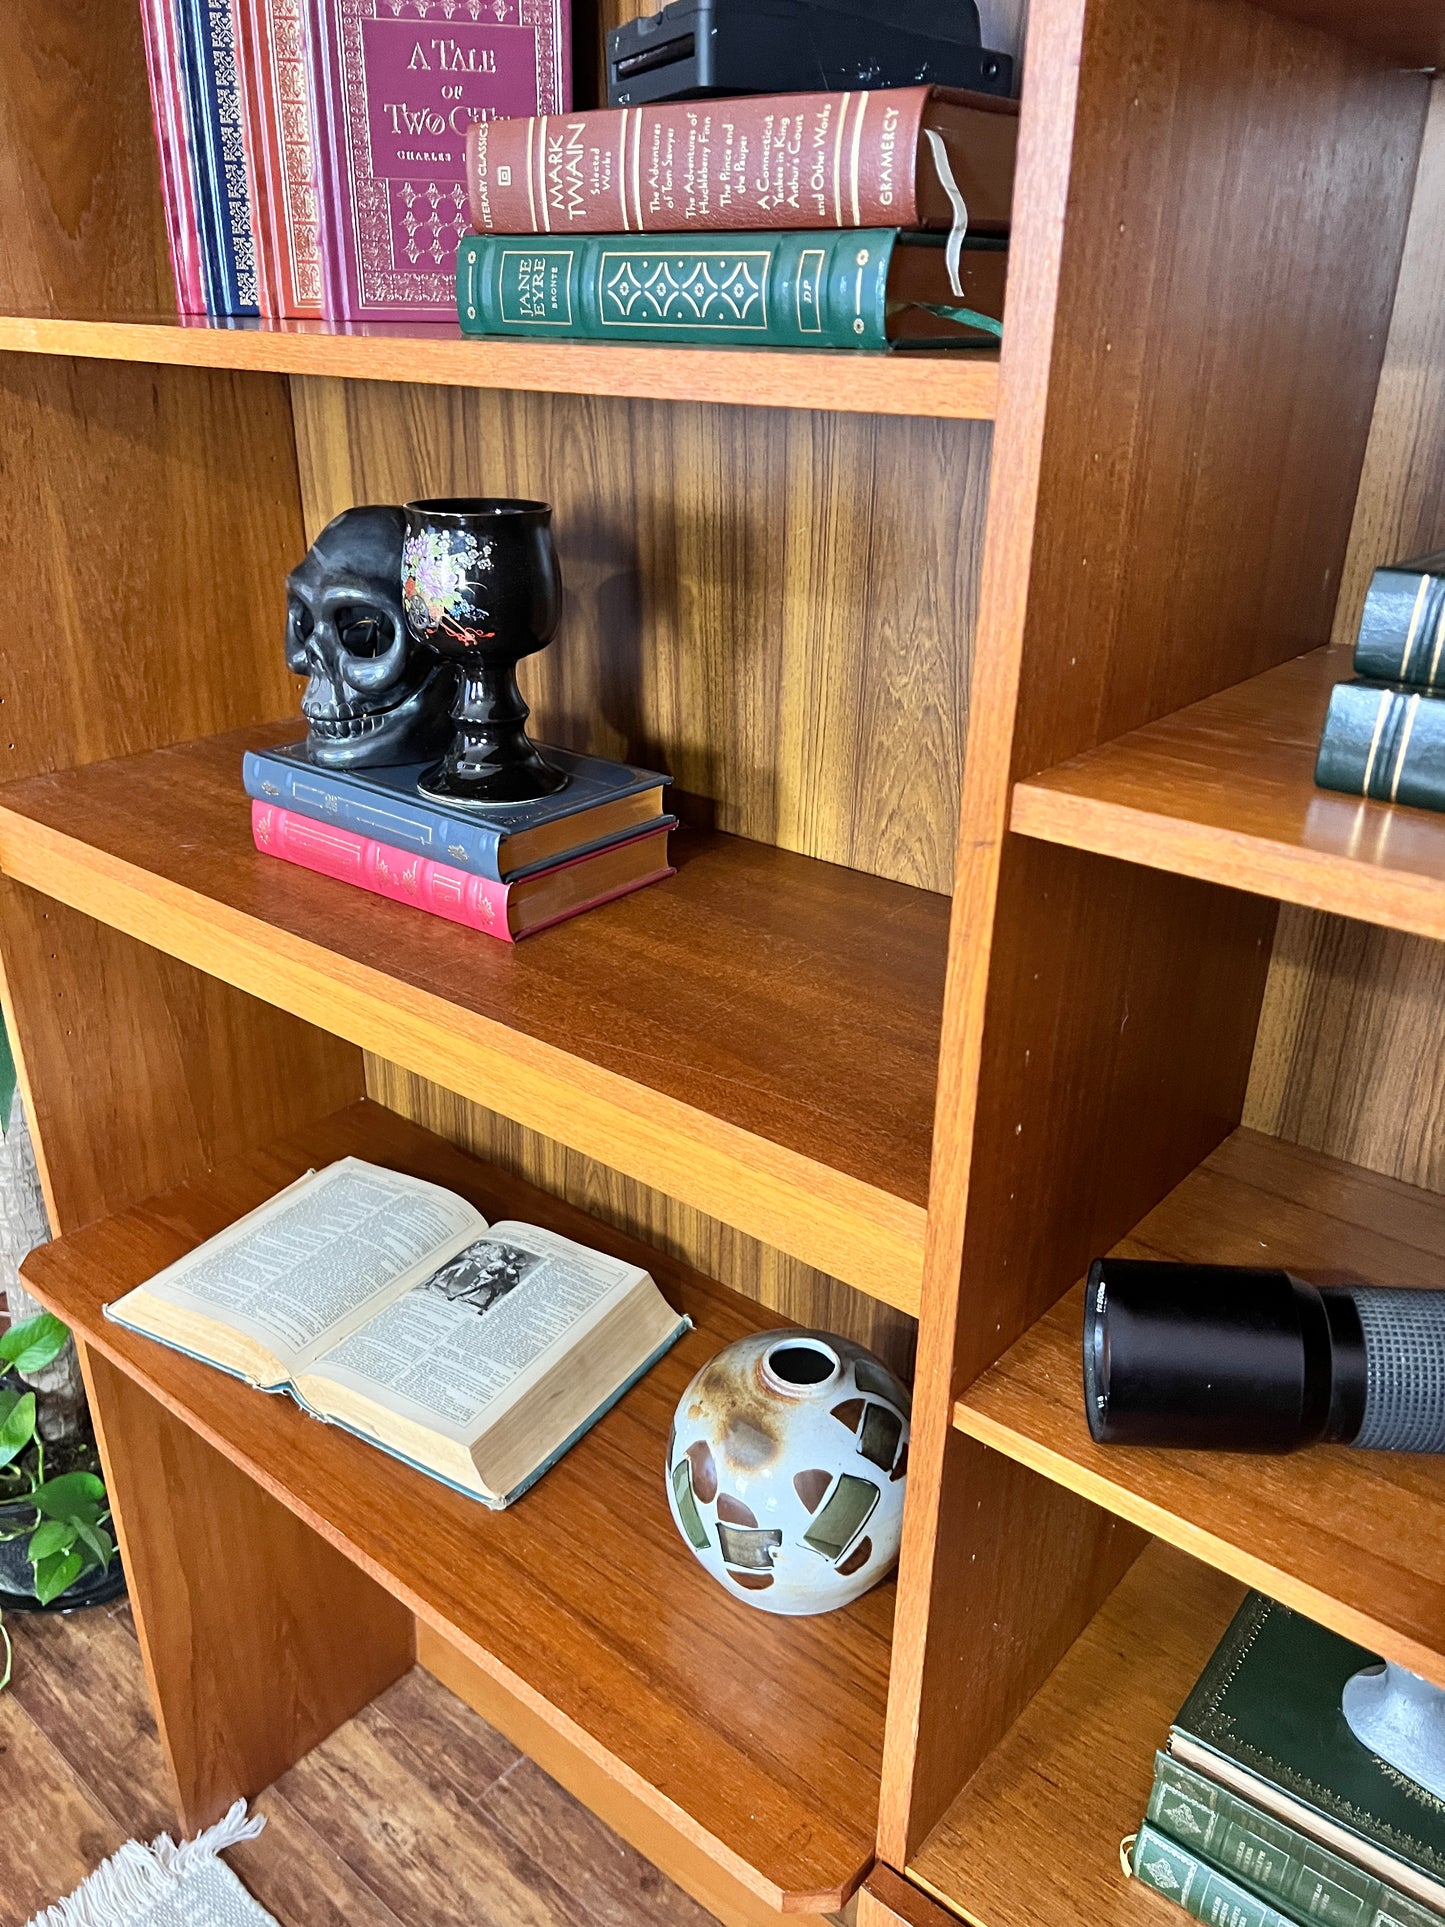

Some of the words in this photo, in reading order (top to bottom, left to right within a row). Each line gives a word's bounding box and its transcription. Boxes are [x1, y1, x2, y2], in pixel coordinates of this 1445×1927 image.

[407, 42, 431, 70] A
[432, 39, 496, 73] TALE
[383, 103, 446, 135] TWO
[687, 112, 697, 126] of
[699, 116, 711, 143] Finn
[722, 124, 734, 145] and
[774, 117, 790, 148] King
[788, 114, 804, 154] Court
[813, 103, 832, 148] Works
[397, 150, 451, 162] CHARLES
[478, 122, 489, 177] CLASSICS
[648, 123, 662, 188] Adventures
[662, 128, 675, 167] Sawyer
[683, 129, 697, 194] Adventures
[719, 149, 732, 181] Prince
[734, 135, 749, 172] Pauper
[756, 114, 774, 192] Connecticut
[776, 152, 784, 163] in
[879, 107, 899, 206] GRAMERCY
[548, 134, 565, 210] MARK
[565, 123, 587, 220] TWAIN
[590, 148, 601, 195] Selected
[602, 151, 612, 190] Works
[662, 170, 673, 193] Tom
[697, 147, 711, 214] Huckleberry
[734, 175, 746, 194] the
[772, 166, 784, 207] Yankee
[787, 159, 800, 209] Arthur's
[811, 150, 825, 190] Other
[478, 180, 493, 228] LITERARY
[650, 191, 661, 213] The
[664, 195, 674, 209] of
[686, 197, 697, 219] The
[719, 184, 732, 207] The
[757, 195, 771, 210] A
[811, 193, 825, 216] and
[518, 259, 534, 317] JANE
[532, 258, 546, 316] EYRE
[803, 280, 812, 304] DP
